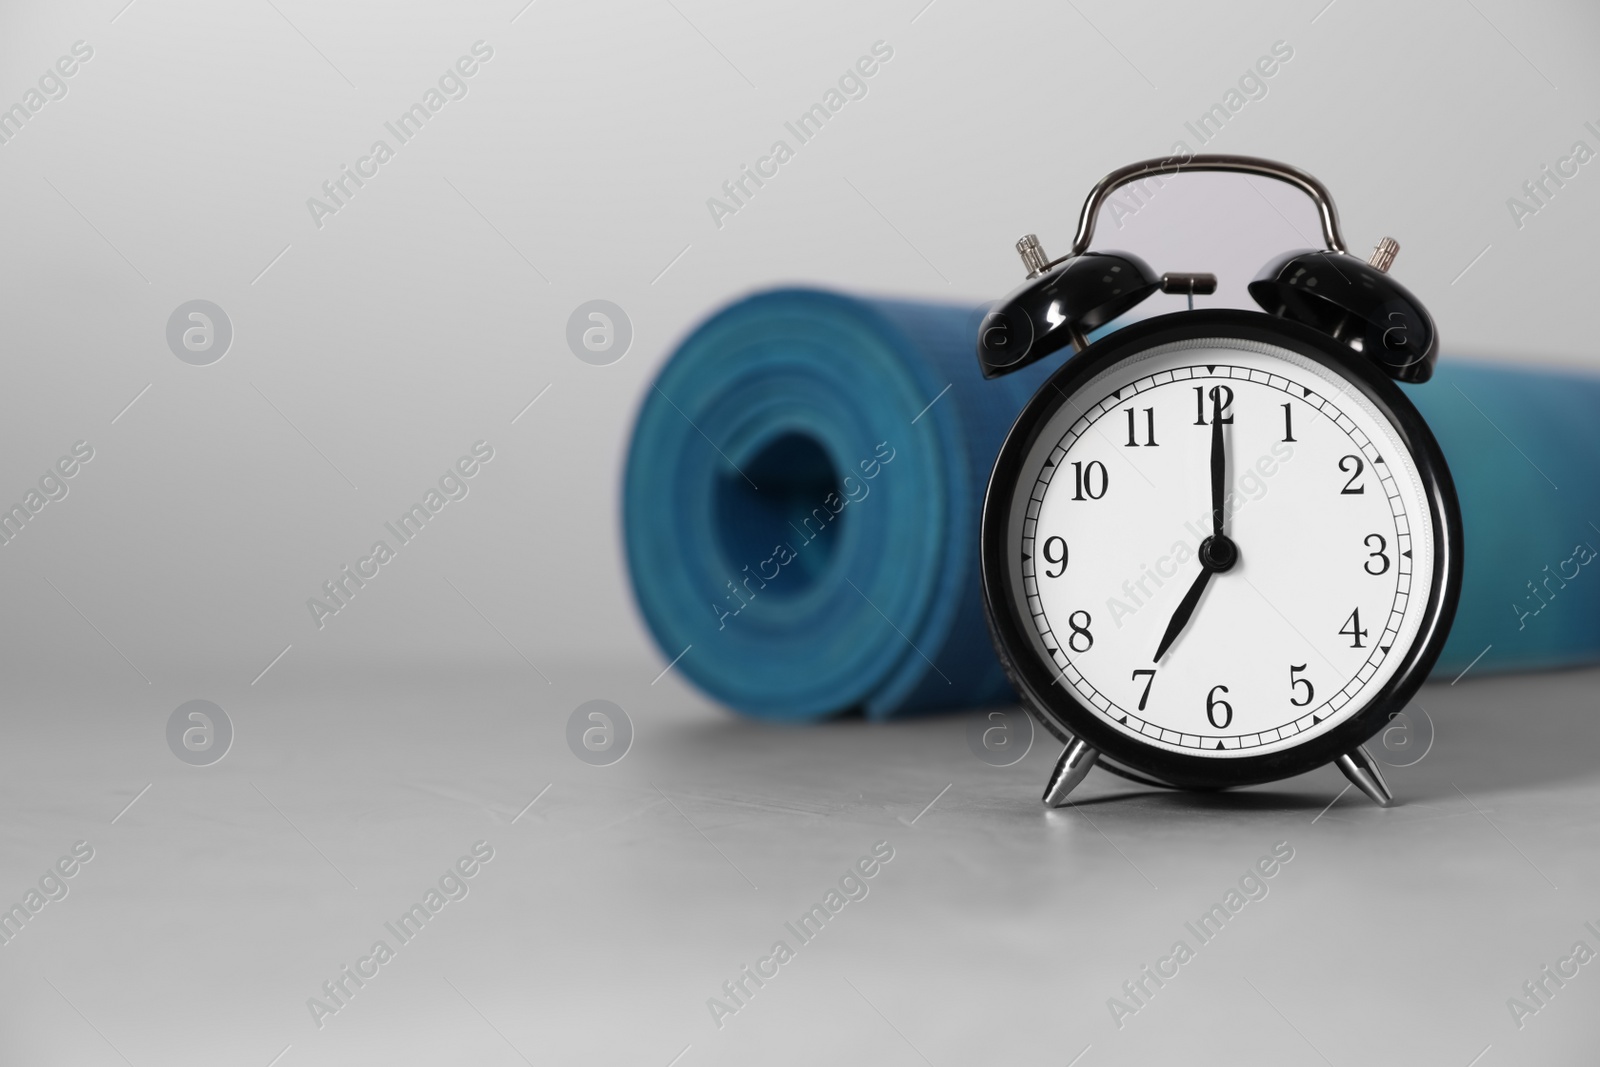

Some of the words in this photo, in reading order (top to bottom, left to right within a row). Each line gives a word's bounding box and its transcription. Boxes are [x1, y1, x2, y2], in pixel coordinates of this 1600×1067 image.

[1193, 385, 1234, 425] 12
[1281, 403, 1297, 442] 1
[1123, 407, 1160, 447] 11
[1071, 461, 1108, 501] 10
[1338, 455, 1365, 495] 2
[1043, 536, 1068, 578] 9
[1364, 534, 1390, 575] 3
[1068, 610, 1094, 652] 8
[1338, 607, 1368, 648] 4
[1132, 669, 1157, 711] 7
[1290, 663, 1315, 706] 5
[1207, 685, 1232, 729] 6
